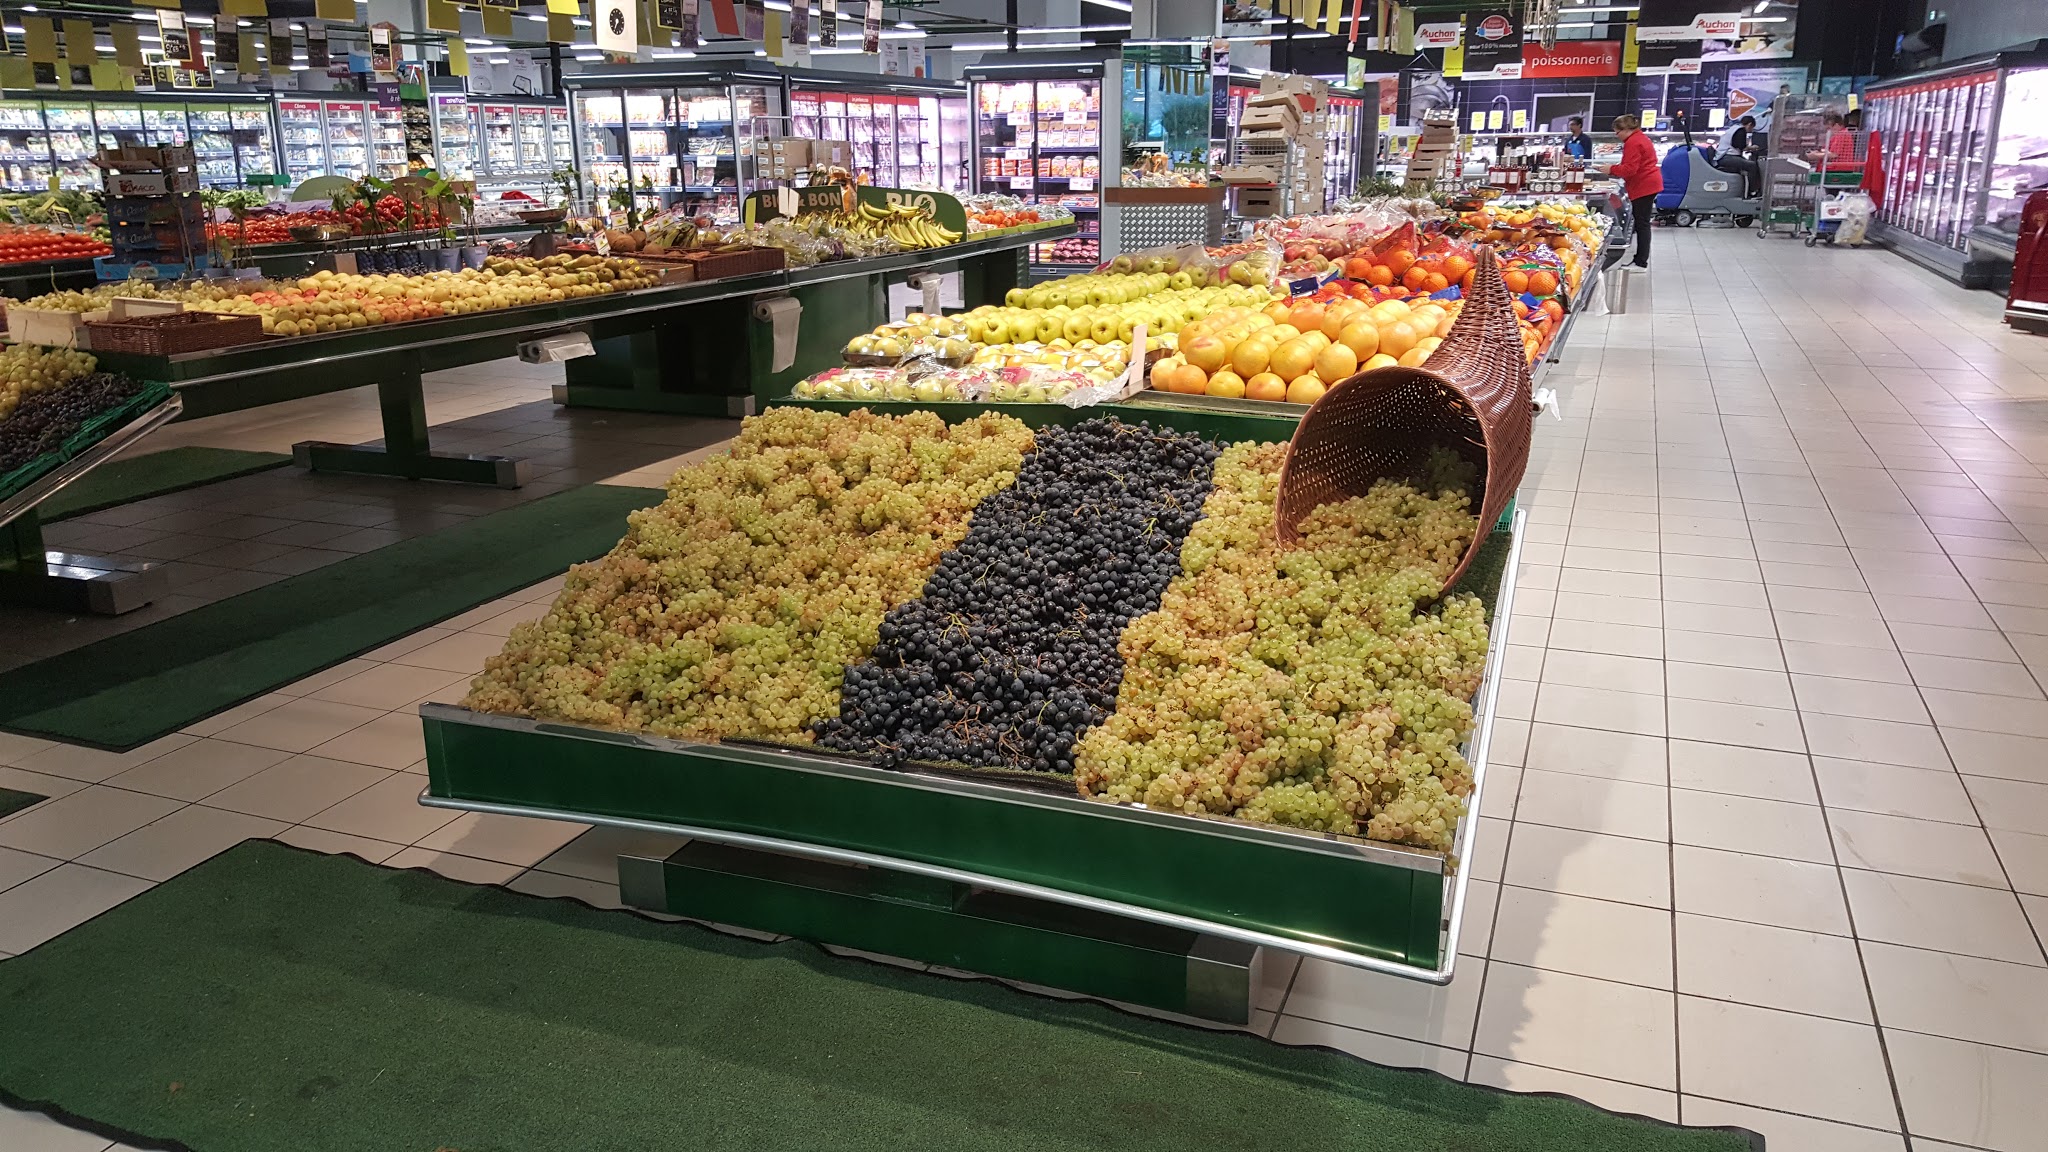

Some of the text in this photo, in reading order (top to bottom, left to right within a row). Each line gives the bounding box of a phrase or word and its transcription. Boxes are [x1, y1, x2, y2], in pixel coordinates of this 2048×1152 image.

[1696, 19, 1735, 29] Auchan
[1420, 28, 1455, 38] Auchan
[1531, 54, 1613, 69] poissonnerie
[762, 194, 780, 208] BI
[808, 192, 842, 206] BON
[886, 193, 936, 220] BIO
